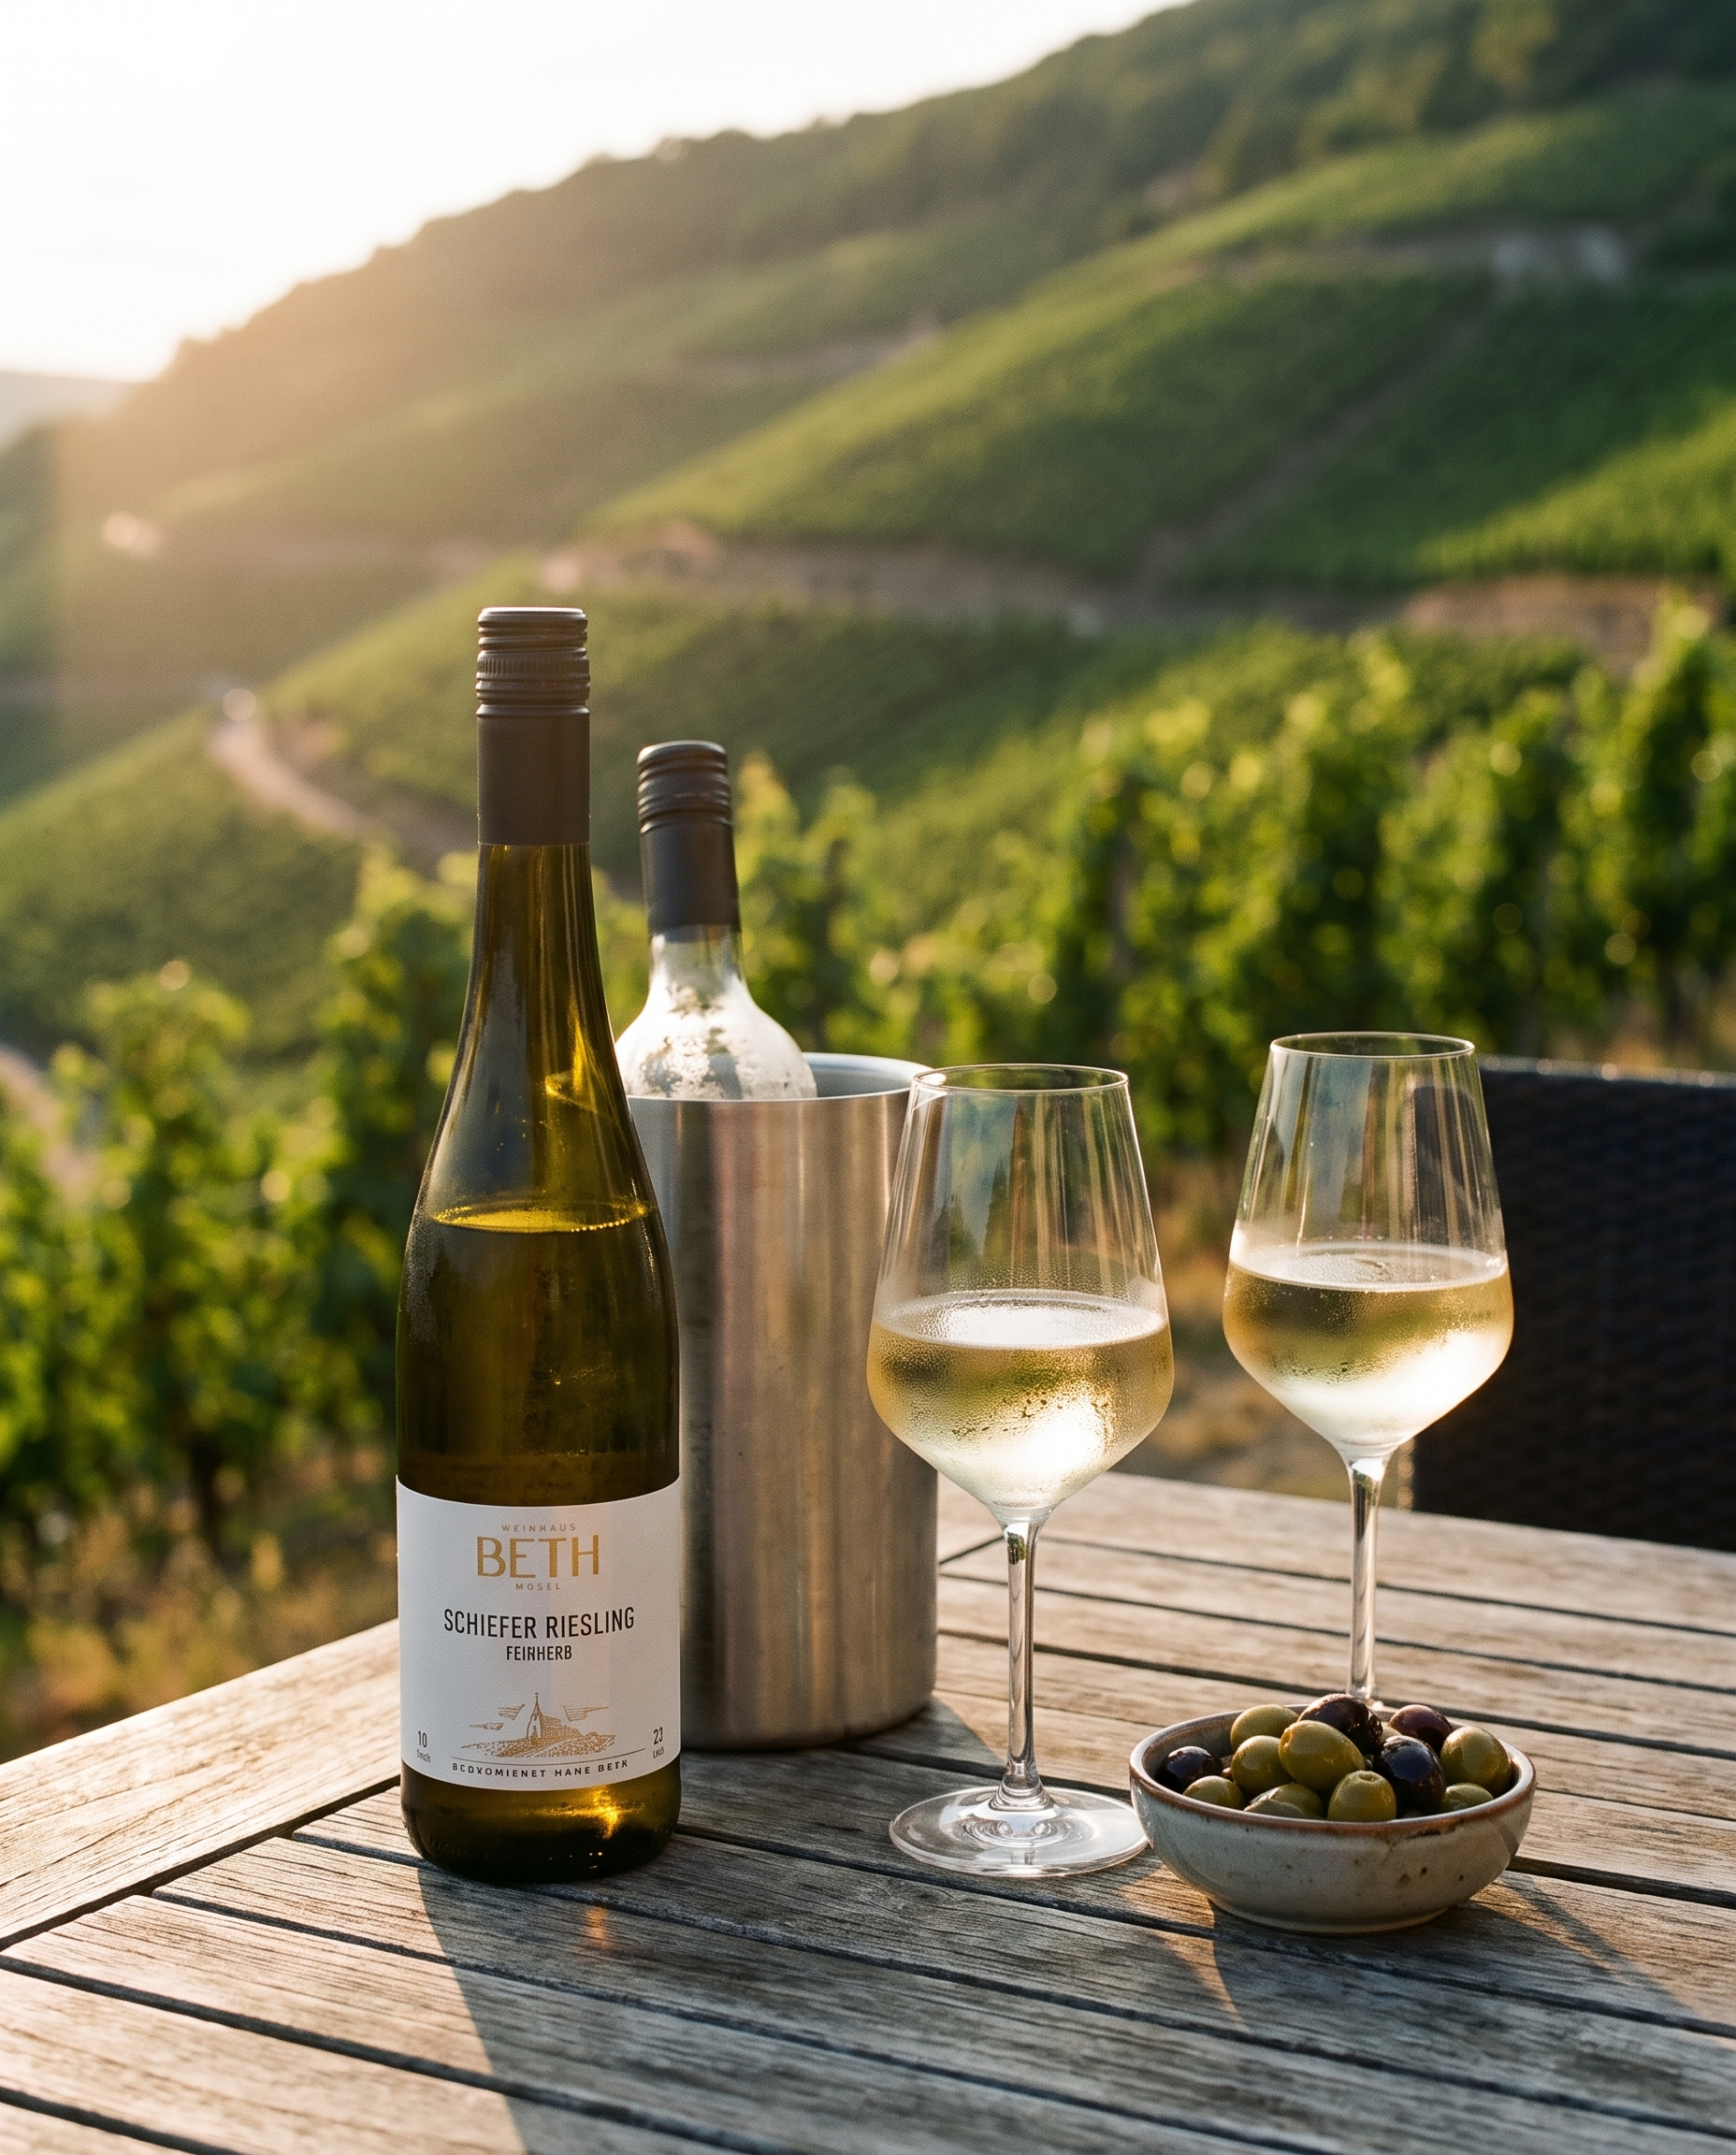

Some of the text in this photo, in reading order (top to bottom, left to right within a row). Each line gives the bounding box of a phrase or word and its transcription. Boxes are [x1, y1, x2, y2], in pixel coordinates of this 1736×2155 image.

[501, 1523, 576, 1532] WEINHAUS
[476, 1534, 600, 1579] BETH
[515, 1583, 561, 1591] MOSEL
[443, 1606, 635, 1639] SCHIEFER RIESLING
[506, 1644, 572, 1661] FEINHERB
[417, 1729, 427, 1748] 10
[653, 1726, 663, 1745] 23
[555, 1766, 590, 1777] HANE
